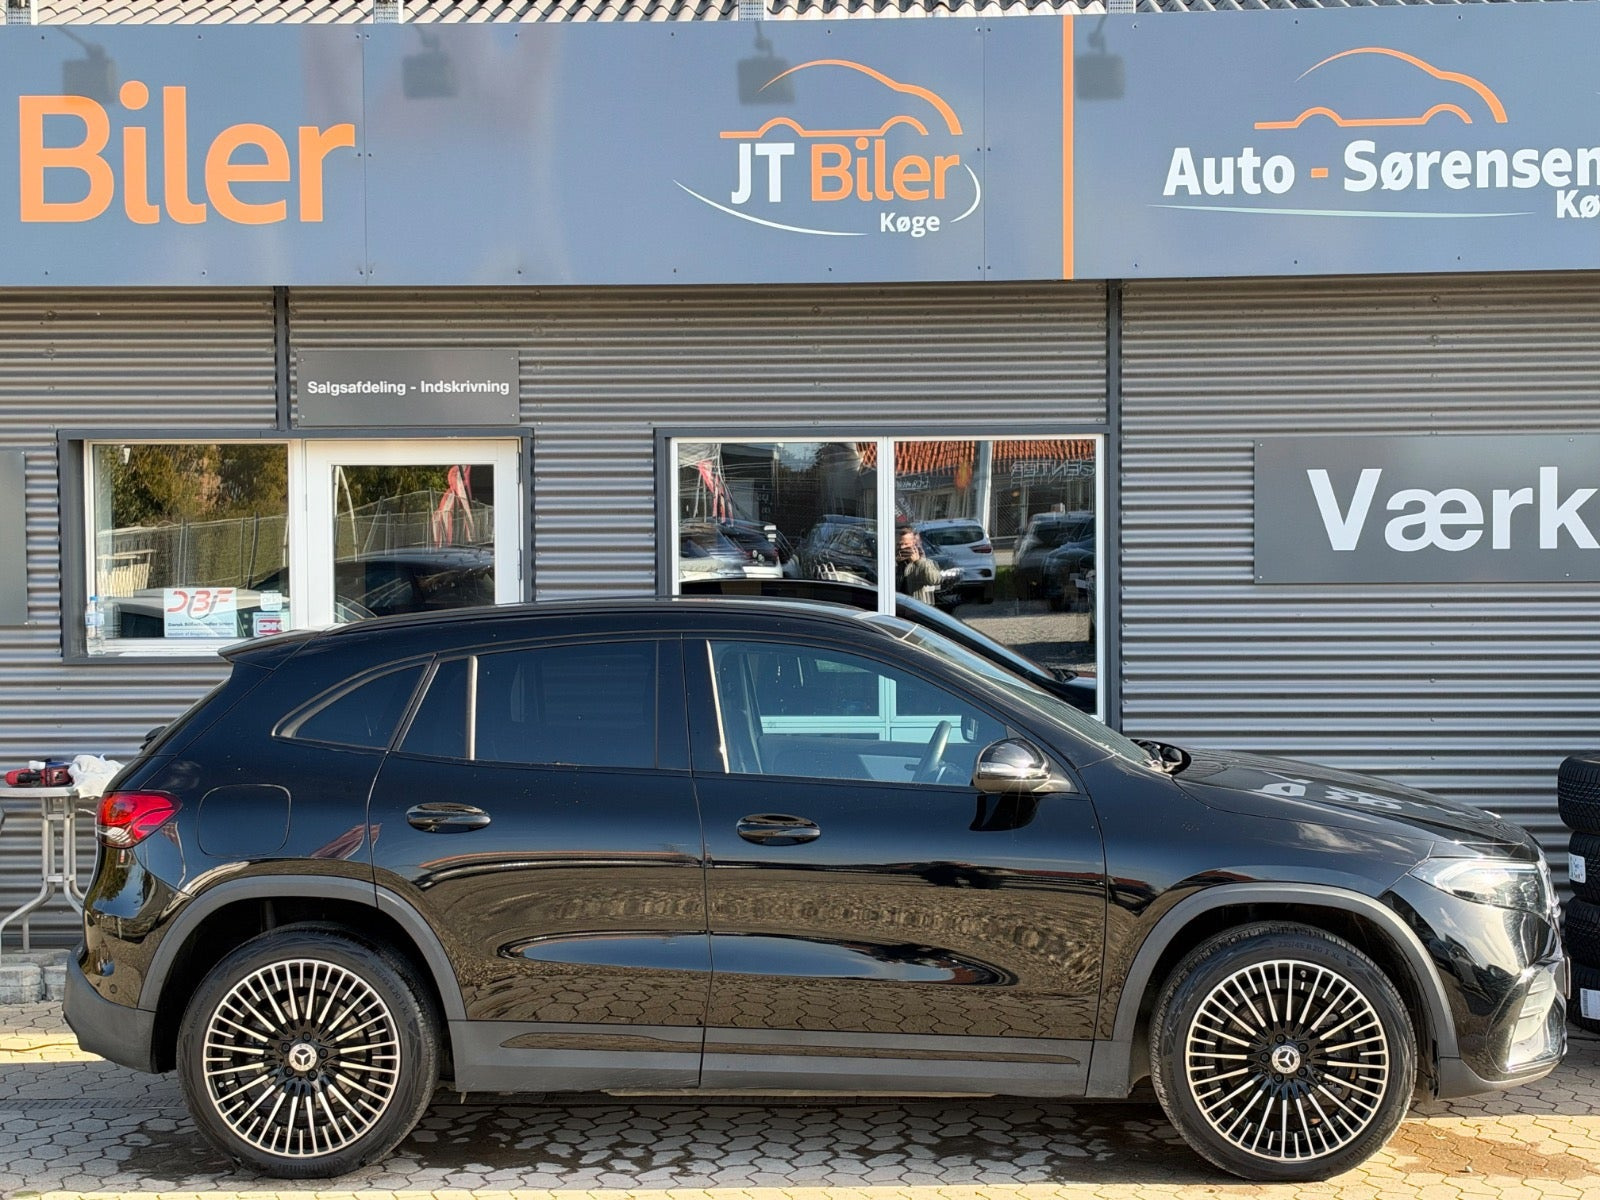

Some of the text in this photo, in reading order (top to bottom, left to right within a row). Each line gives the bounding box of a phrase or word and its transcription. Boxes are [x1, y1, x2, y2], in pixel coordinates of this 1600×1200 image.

[19, 80, 356, 225] Biler
[731, 137, 960, 204] JT Biler
[1163, 147, 1295, 197] Auto
[1344, 139, 1600, 193] Sørensen
[880, 212, 941, 237] Køge
[307, 380, 407, 397] Salgsafdeling
[420, 379, 510, 396] Indskrivning
[1306, 466, 1600, 552] Værk
